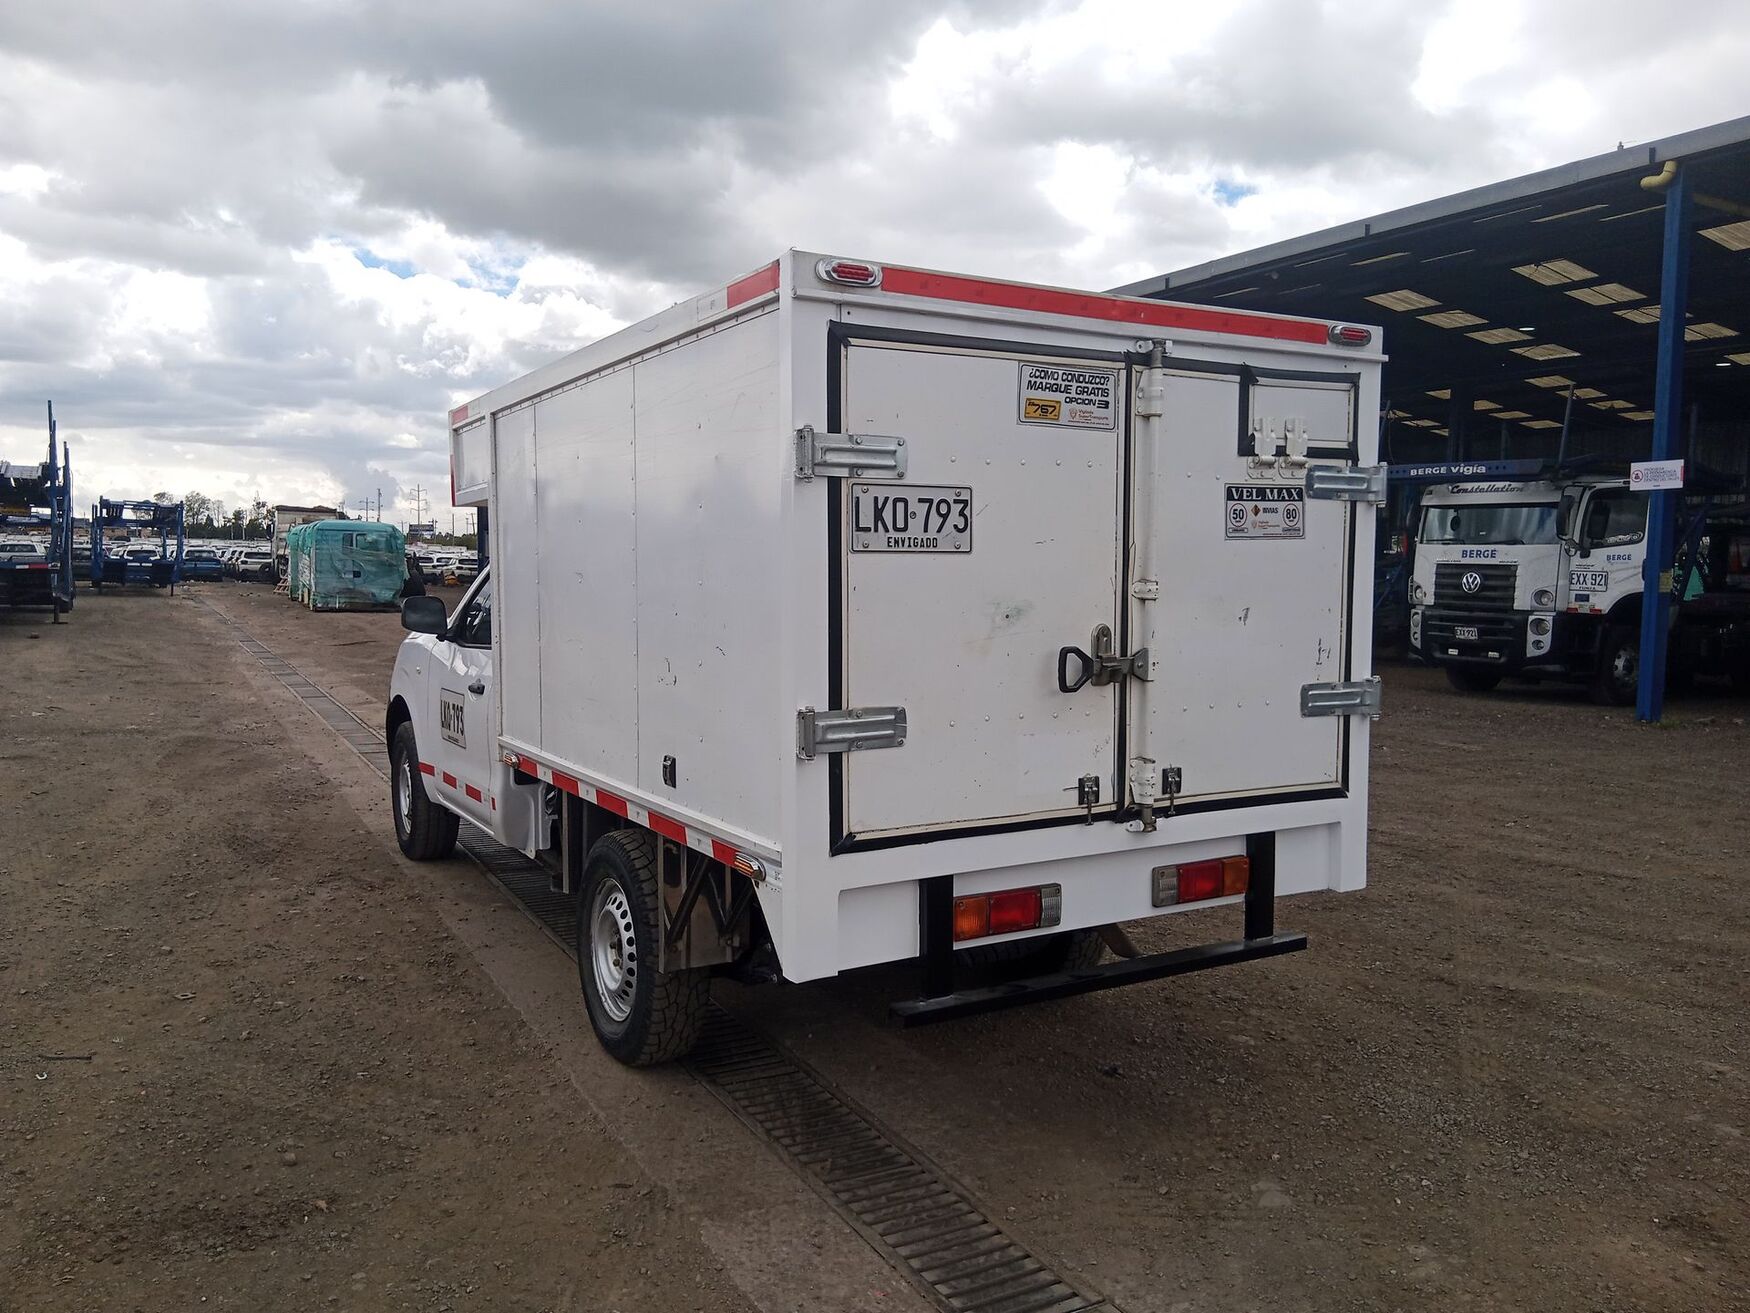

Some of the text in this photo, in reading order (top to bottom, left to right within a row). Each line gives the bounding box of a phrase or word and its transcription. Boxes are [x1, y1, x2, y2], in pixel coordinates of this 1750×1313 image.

[1029, 368, 1110, 386] ¿COMO CONDUZCO?
[1027, 380, 1110, 398] MARQUE GRATIS
[1064, 396, 1110, 410] OPCION 3
[1033, 404, 1057, 415] 767
[1450, 463, 1487, 475] vigía
[1231, 487, 1299, 501] VEL MAX
[1449, 483, 1524, 495] Constellation
[1232, 508, 1245, 520] 50
[1285, 508, 1297, 520] 80
[887, 536, 938, 548] ENVIGADO
